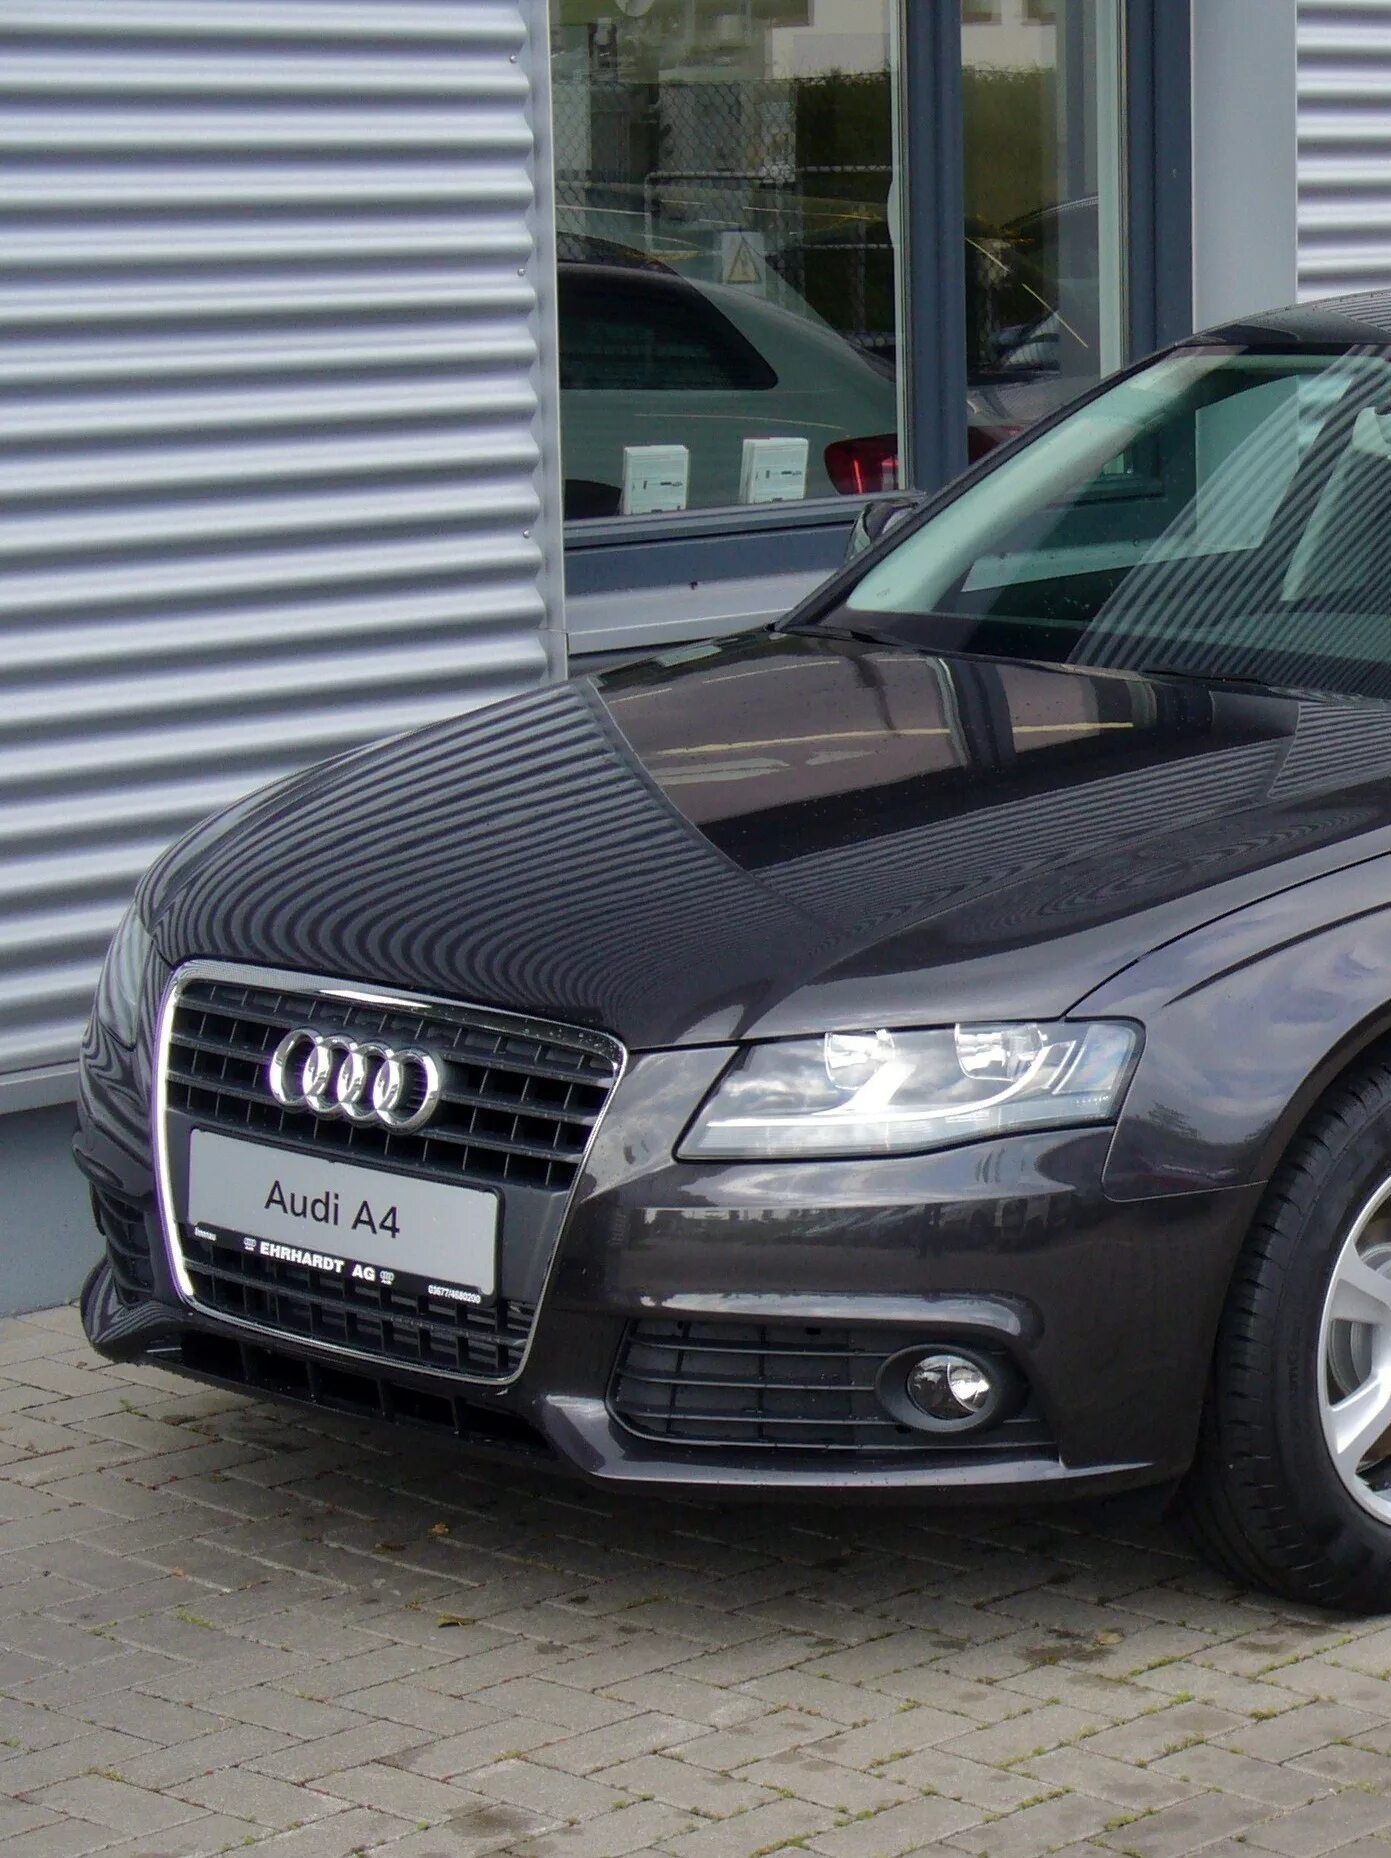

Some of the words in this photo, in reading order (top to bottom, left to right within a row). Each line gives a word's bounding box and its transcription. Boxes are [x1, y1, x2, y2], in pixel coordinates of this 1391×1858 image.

[264, 1180, 340, 1226] Audi
[351, 1200, 400, 1239] A4
[259, 1242, 345, 1274] EHRHARDT
[351, 1264, 377, 1282] AG
